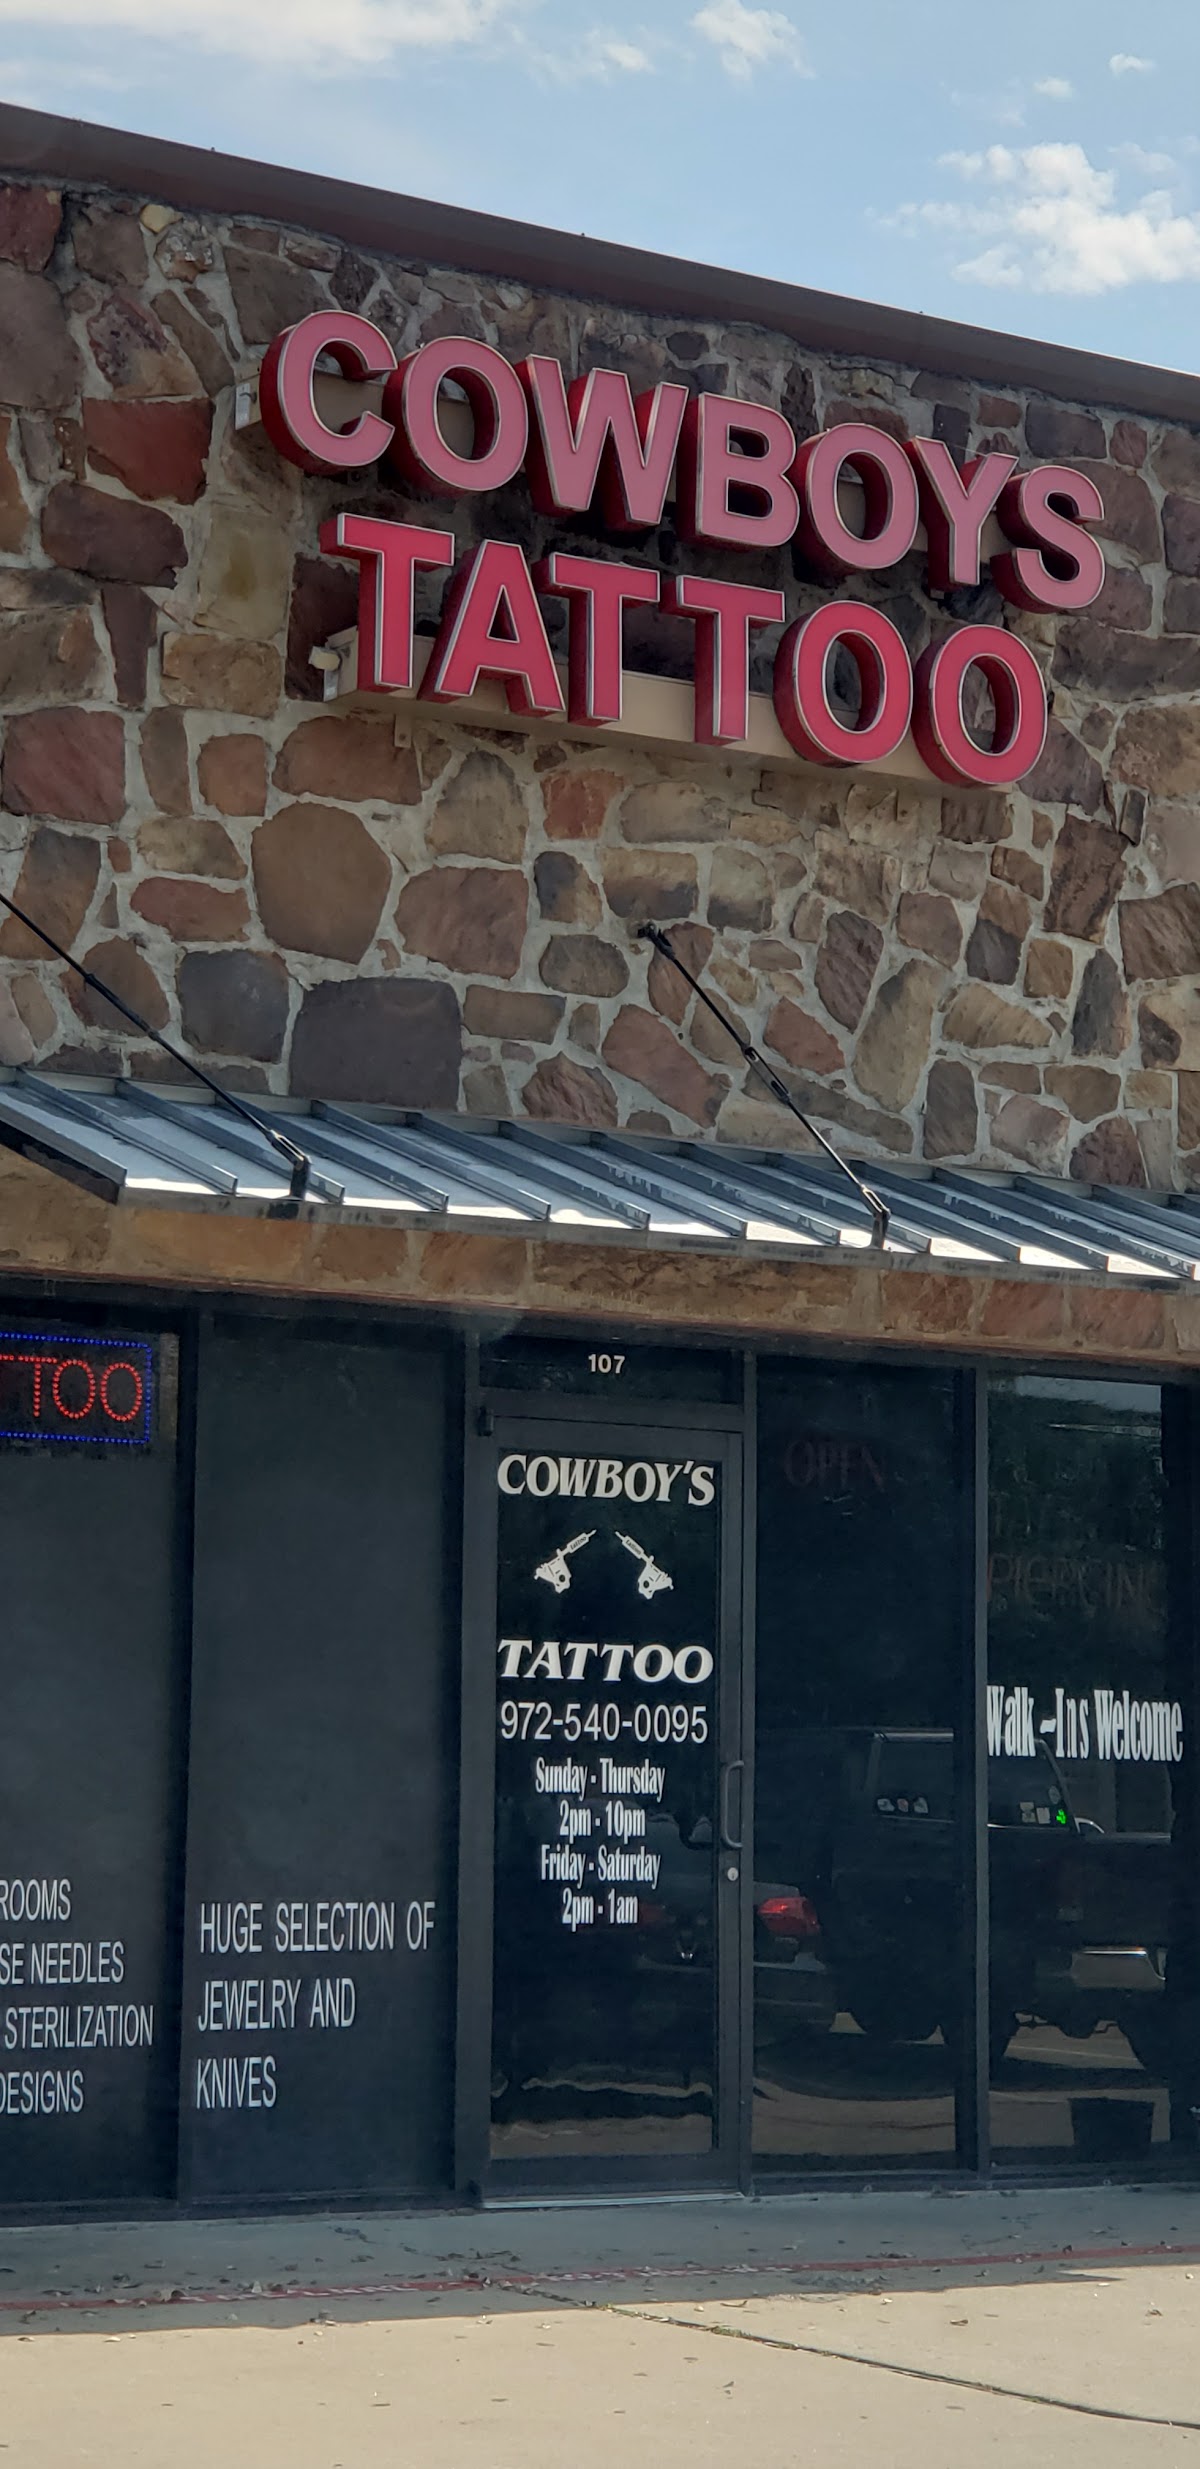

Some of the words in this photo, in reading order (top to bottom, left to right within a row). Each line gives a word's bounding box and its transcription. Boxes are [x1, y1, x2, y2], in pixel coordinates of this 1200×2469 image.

[262, 310, 1105, 611] COWBOYS
[320, 512, 1048, 788] TATTOO
[588, 1353, 625, 1374] 107
[497, 1454, 715, 1506] COWBOY'S
[497, 1639, 714, 1684] TATTOO
[500, 1700, 708, 1744] 972-540-0095
[986, 1685, 1036, 1757] Walk
[1093, 1689, 1184, 1762] Welcome
[535, 1756, 588, 1802] Sunday
[599, 1757, 666, 1803] Thursday
[559, 1799, 592, 1844] 2pm
[605, 1800, 646, 1845] 10pm
[541, 1844, 586, 1890] Friday
[597, 1844, 661, 1890] Saturday
[200, 1902, 263, 1953] HUGE
[275, 1901, 395, 1952] SELECTION
[406, 1901, 435, 1950] OF
[562, 1887, 594, 1932] 2pm
[608, 1888, 638, 1924] 1am
[31, 1941, 124, 1984] NEEDLES
[5, 2004, 153, 2049] STERILIZATION
[198, 1979, 301, 2031] JEWELRY
[309, 1977, 356, 2028] AND
[196, 2055, 277, 2109] KNIVES
